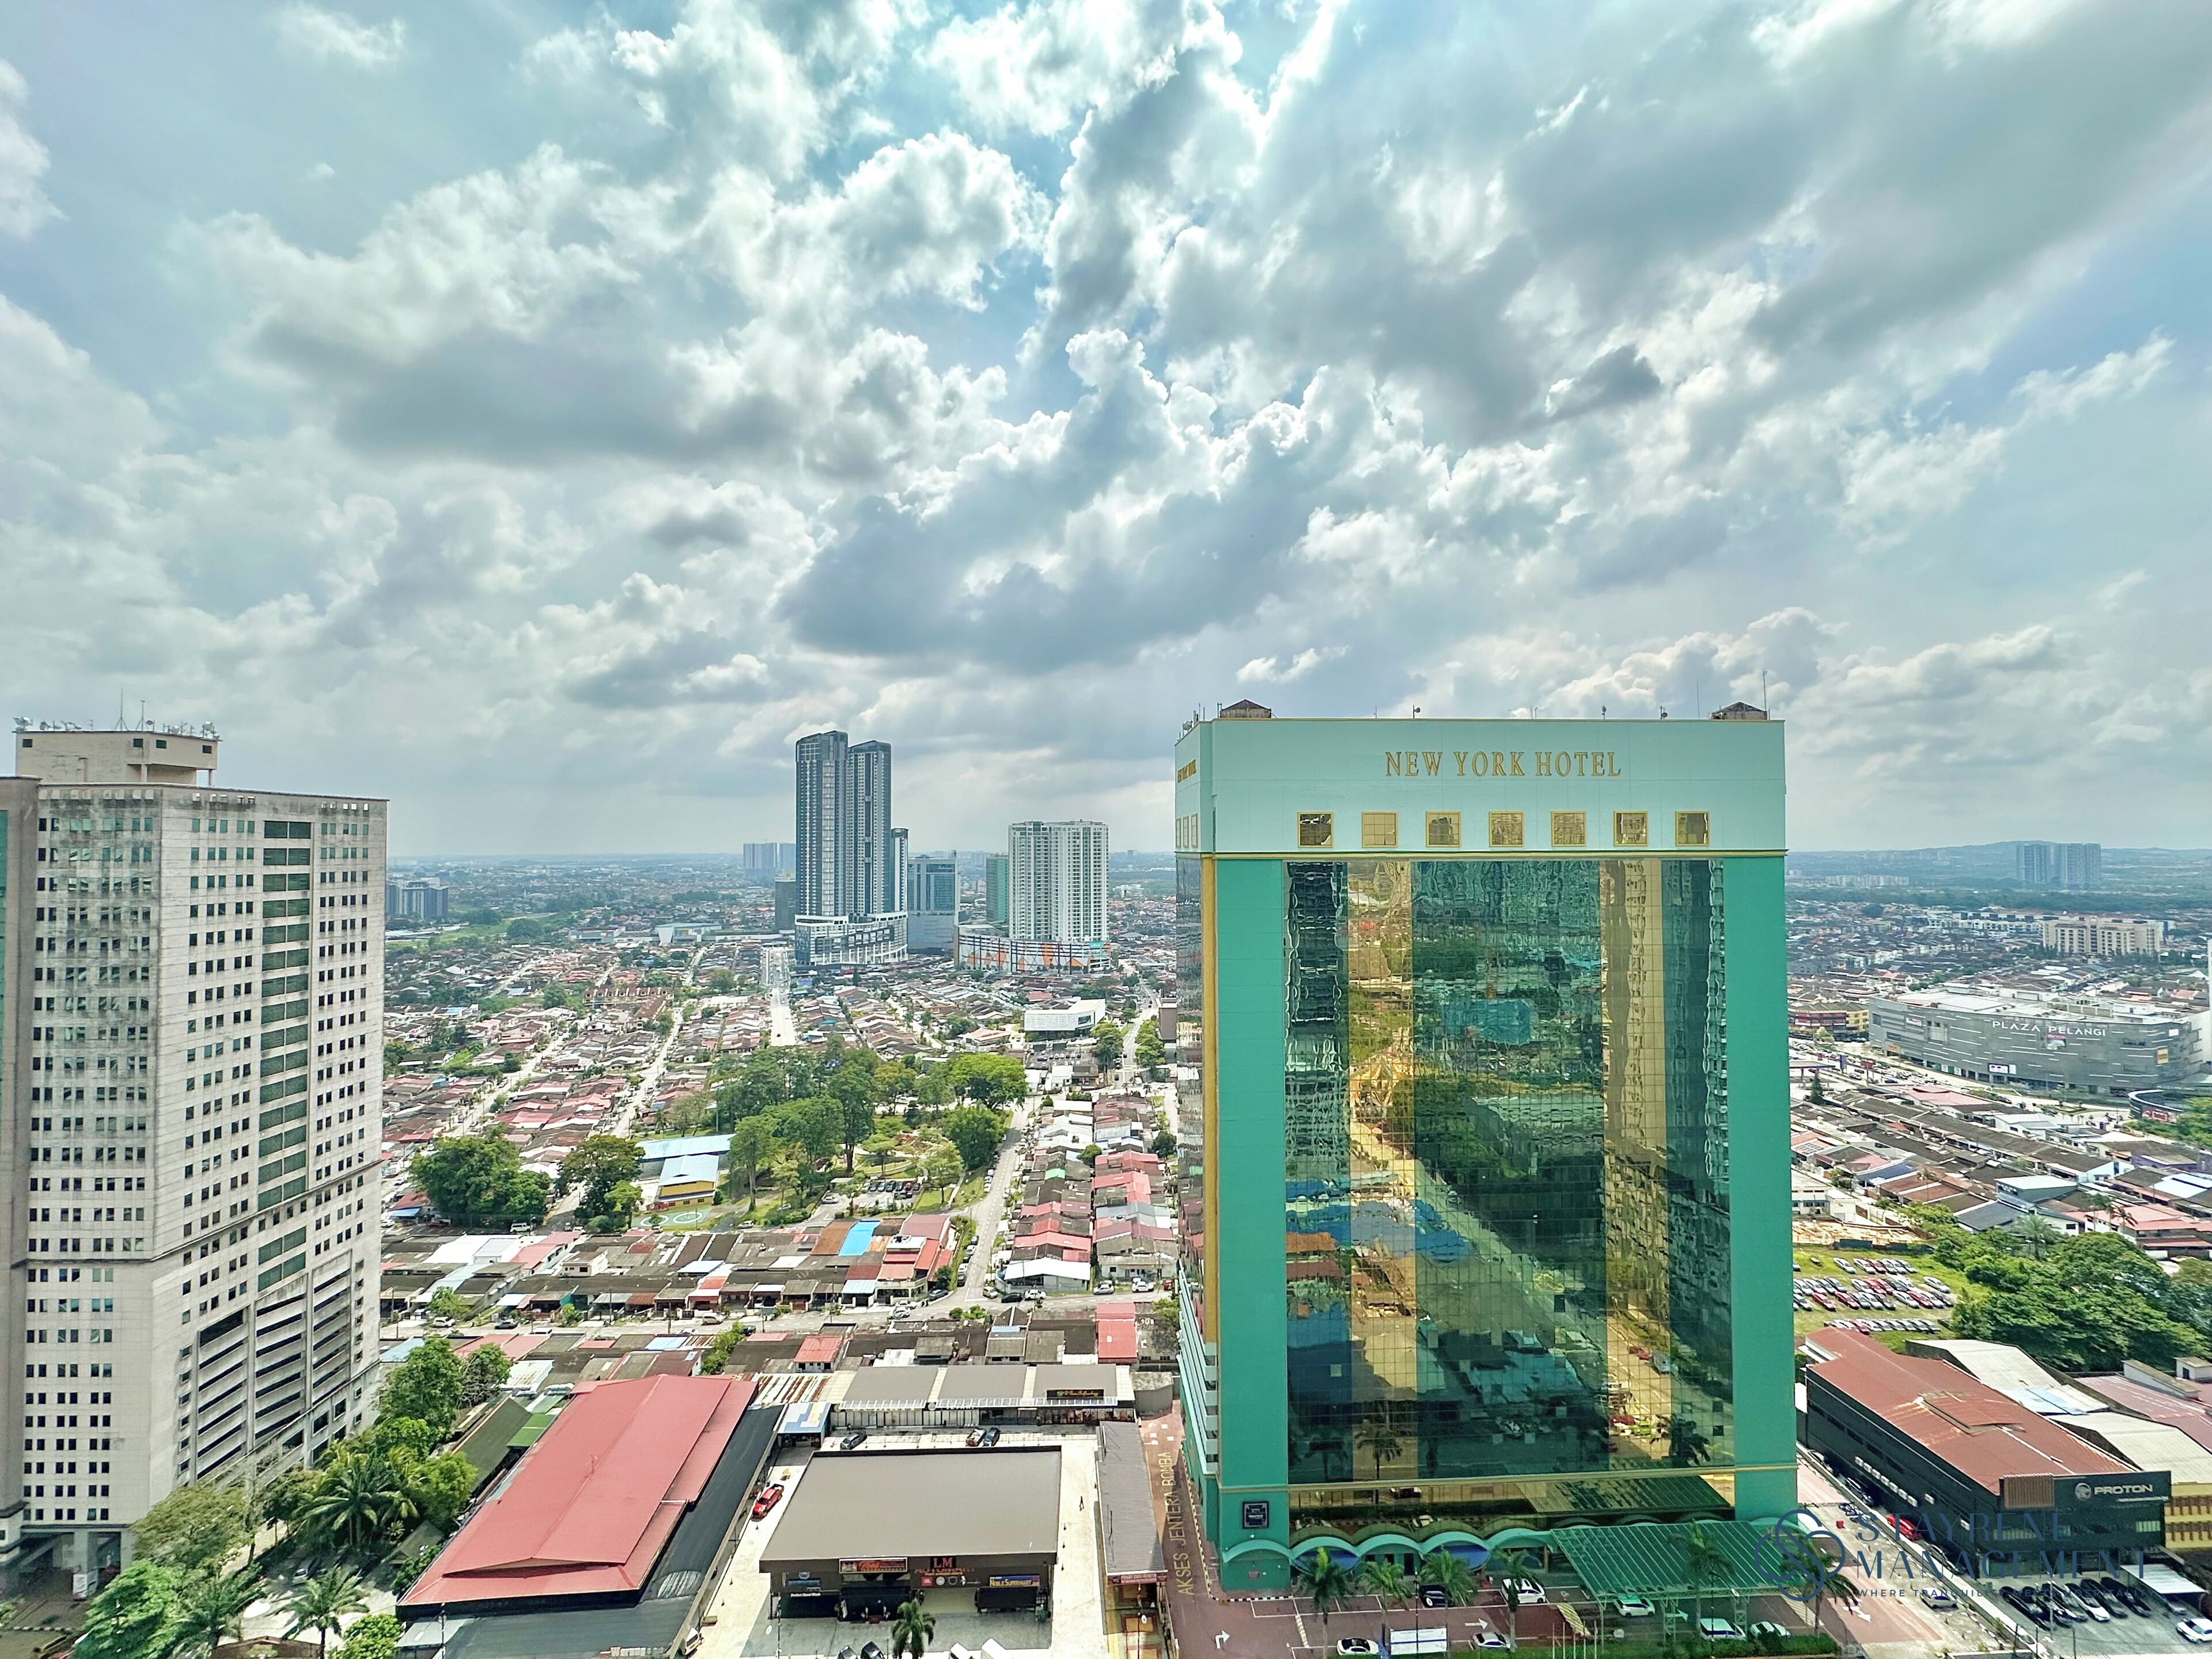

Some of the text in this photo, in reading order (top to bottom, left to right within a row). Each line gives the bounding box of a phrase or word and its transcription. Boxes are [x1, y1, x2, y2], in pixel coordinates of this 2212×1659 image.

[1385, 751, 1622, 777] NEW YORK HOTEL
[1992, 1020, 2106, 1036] PLAZA PELANGI
[2094, 1484, 2153, 1495] PROTON
[1157, 1452, 1194, 1595] AKSES JENTERA BOMBA
[933, 1557, 953, 1568] LM
